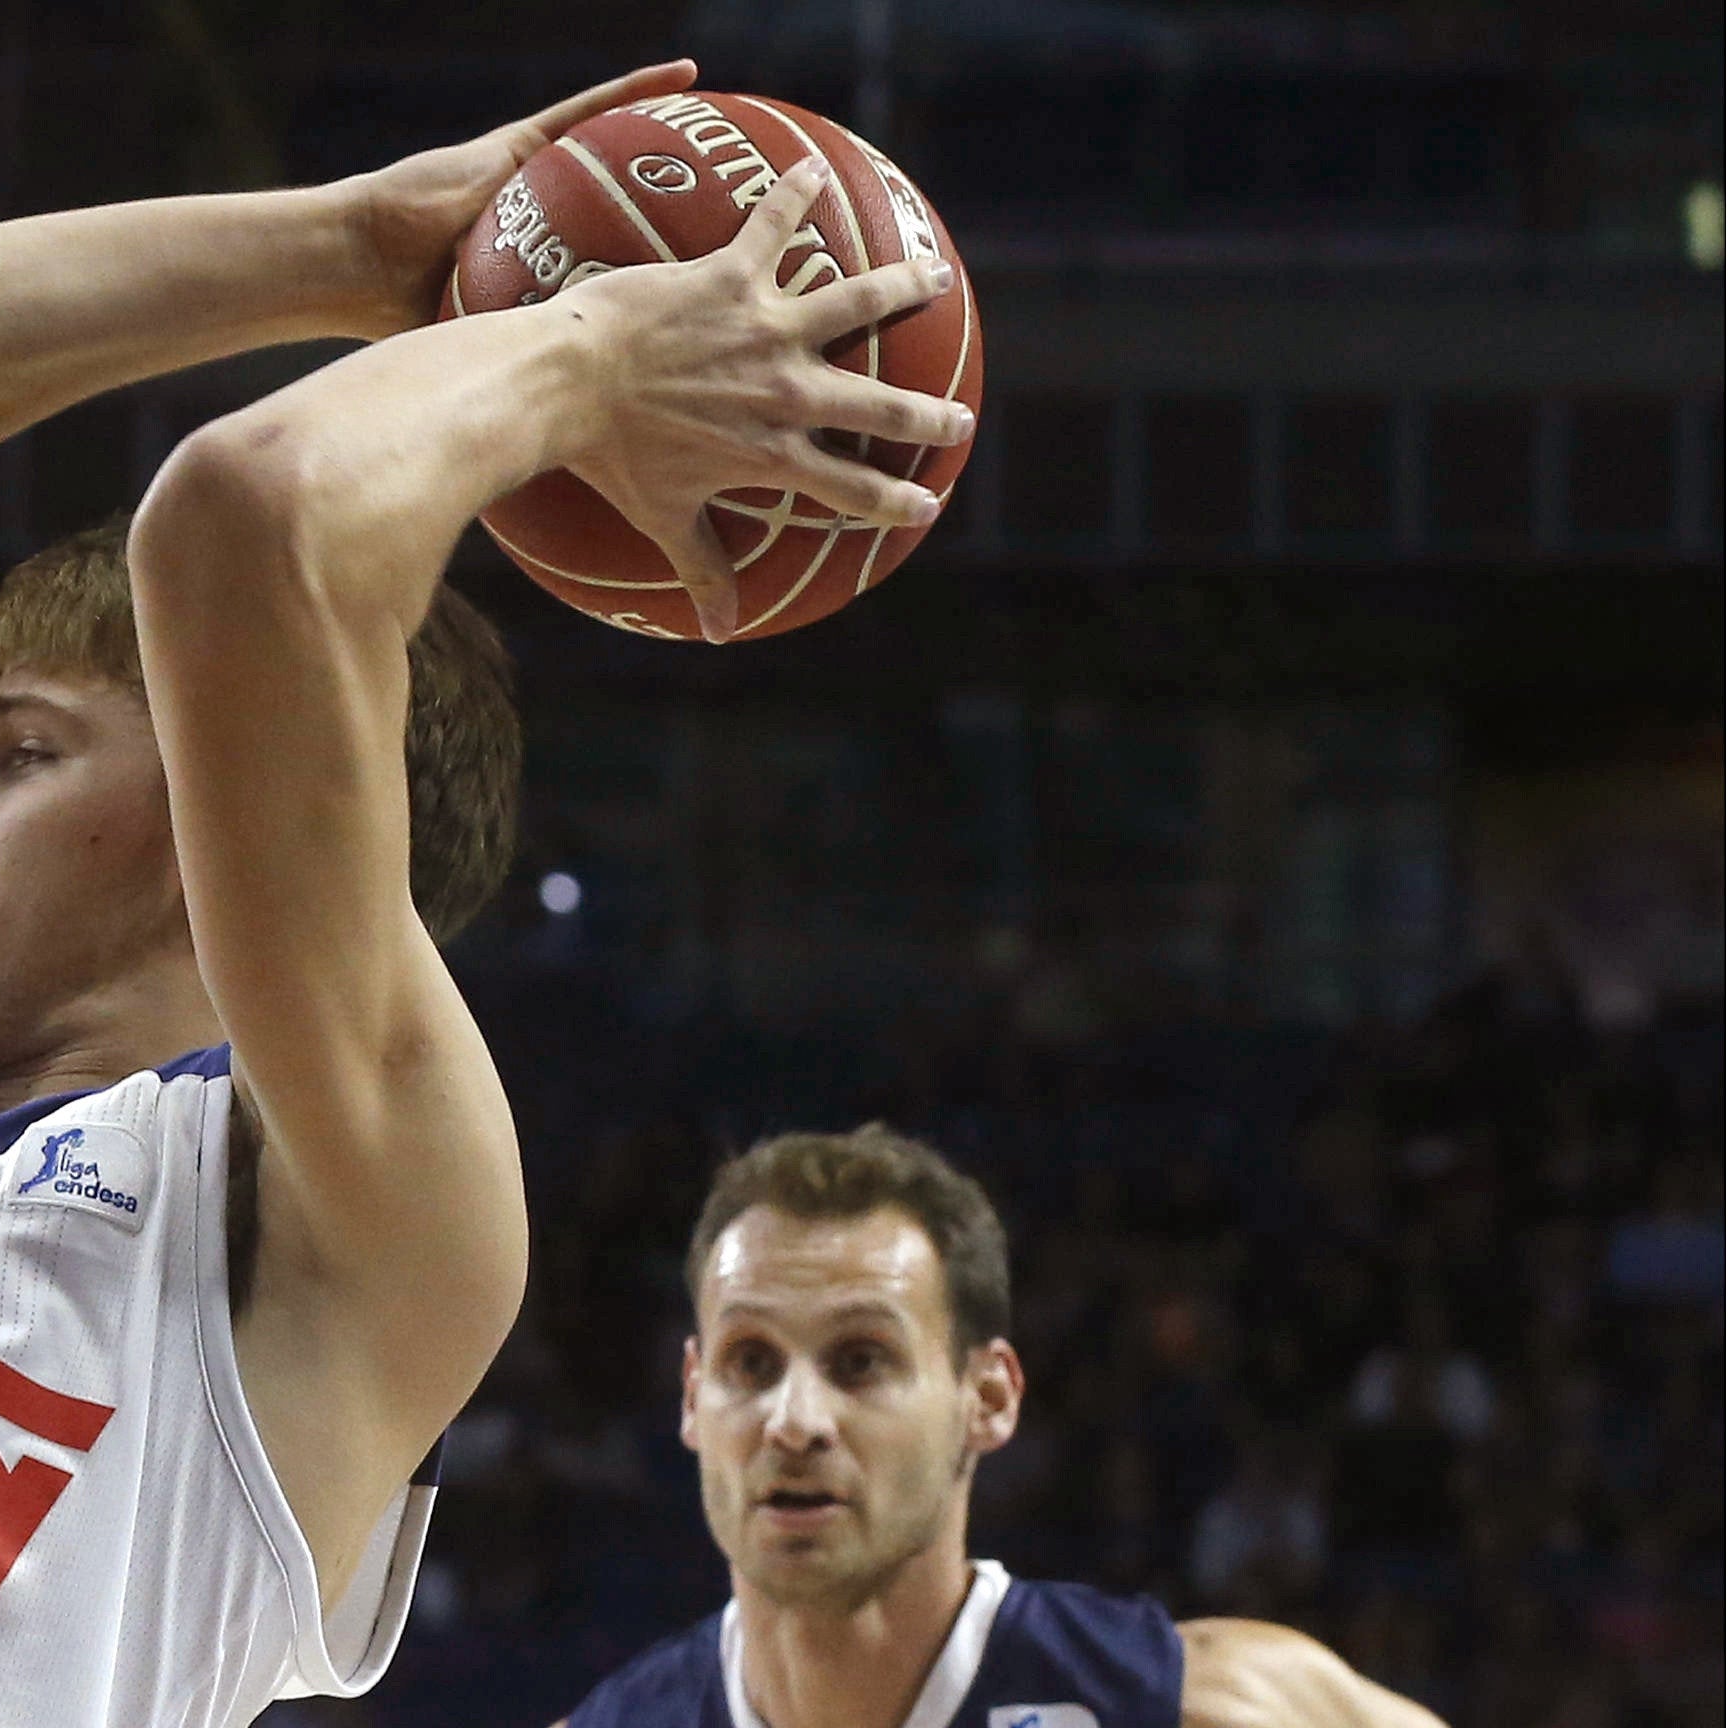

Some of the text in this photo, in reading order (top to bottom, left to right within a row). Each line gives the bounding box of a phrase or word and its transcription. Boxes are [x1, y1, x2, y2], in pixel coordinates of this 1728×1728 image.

[496, 174, 574, 286] endes
[609, 93, 845, 296] SALDIN
[54, 1181, 138, 1214] endesa
[60, 1148, 99, 1180] liga
